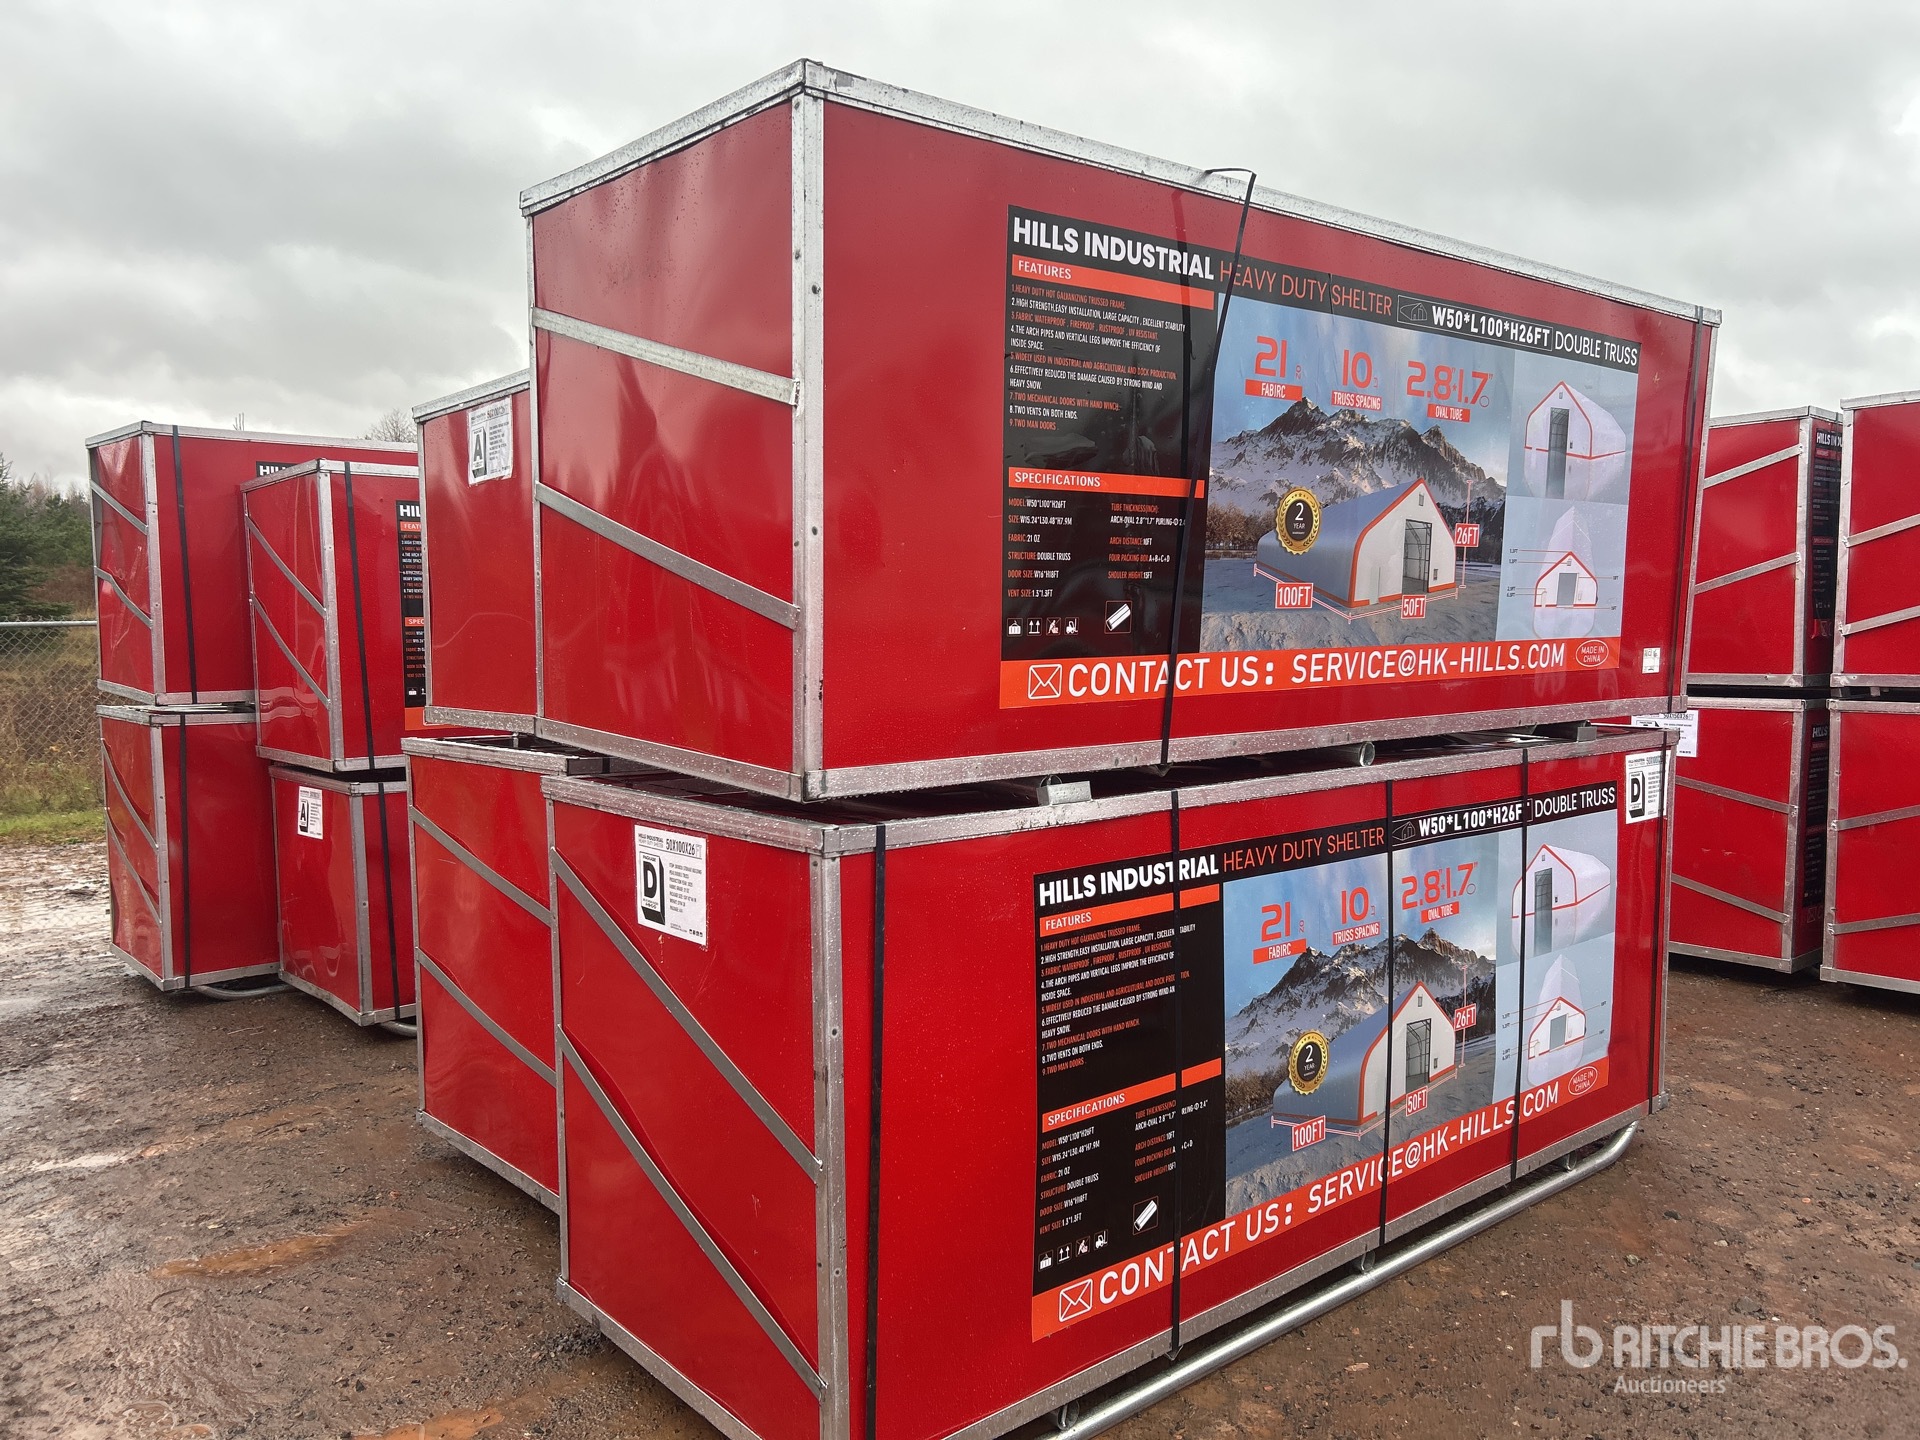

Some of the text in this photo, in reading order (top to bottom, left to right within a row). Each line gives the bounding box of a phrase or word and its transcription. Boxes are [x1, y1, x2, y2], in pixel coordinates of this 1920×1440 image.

[1018, 260, 1071, 280] FEATURES
[1013, 217, 1078, 253] HILLS
[1085, 231, 1214, 280] INDUSTRIAL
[1220, 261, 1277, 292] HEAVY
[1282, 275, 1328, 302] DUTY
[1332, 284, 1392, 316] SHELTER
[1556, 331, 1600, 358] DOUBLE
[1604, 342, 1637, 365] TRUSS
[1032, 287, 1044, 296] DUTY
[1046, 290, 1055, 298] HOT
[1103, 311, 1117, 321] LARGE
[1143, 318, 1164, 328] EXCELLENT
[1165, 321, 1185, 332] STABILITY
[1011, 338, 1026, 347] INSIDE
[1026, 327, 1039, 336] ARCH
[1041, 329, 1053, 338] PIPES
[1055, 331, 1065, 339] AND
[1066, 332, 1088, 343] VERTICAL
[1090, 335, 1100, 344] LEGS
[1102, 338, 1121, 347] IMPROVE
[1132, 341, 1154, 352] EFFICIENCY
[1034, 354, 1046, 363] USED
[1048, 356, 1052, 364] IN
[1054, 357, 1081, 367] INDUSTRIAL
[1083, 361, 1092, 369] AND
[1128, 366, 1136, 374] AND
[1255, 335, 1287, 378] 21
[1342, 349, 1373, 388] 10
[1010, 379, 1025, 387] HEAVY
[1045, 369, 1066, 379] REDUCED
[1068, 371, 1076, 380] THE
[1077, 373, 1096, 382] DAMAGE
[1098, 376, 1115, 384] CAUSED
[1124, 379, 1140, 388] STRONG
[1142, 381, 1153, 389] WIND
[1154, 382, 1162, 390] AND
[1261, 382, 1286, 398] FABIRC
[1027, 394, 1102, 408] MECHANICAL DOORS WITH HAND
[1334, 392, 1381, 410] TRUSS SPACING
[1010, 405, 1063, 418] 8.TWO VENTS ON BOTH
[1435, 405, 1463, 421] OVAL TUBE
[1027, 420, 1038, 428] MAN
[1816, 432, 1830, 444] HILLS
[474, 434, 482, 461] A
[1014, 472, 1100, 487] SPECIFICATIONS
[1295, 503, 1303, 520] 2
[1456, 527, 1478, 544] 26FT
[1008, 570, 1021, 578] DOOR
[1278, 586, 1311, 606] 100FT
[1403, 598, 1424, 616] 50FT
[1069, 643, 1565, 696] CONTACT US: SERVICE@HK-HILLS.COM
[1631, 778, 1640, 803] D
[300, 803, 306, 821] A
[1039, 874, 1096, 907] HILLS
[1223, 844, 1278, 872] HEAVY
[1282, 836, 1323, 862] DUTY
[1327, 827, 1384, 854] SHELTER
[1419, 802, 1530, 837] W50L100H26F
[1535, 792, 1577, 818] DOUBLE
[1580, 786, 1615, 808] TRUSS
[643, 861, 657, 898] D
[1342, 887, 1369, 924] 10
[1428, 904, 1453, 920] OVAL TUBE
[1046, 912, 1092, 931] FEATURES
[1261, 902, 1290, 942] 21
[1121, 933, 1154, 947] LARGE CAPACITY
[1335, 923, 1379, 945] TRUSS SPACING
[1268, 944, 1291, 959] FABIRC
[1055, 977, 1067, 985] ARCH
[1068, 973, 1080, 983] PIPES
[1081, 971, 1090, 980] AND
[1091, 967, 1109, 977] VERTICAL
[1111, 964, 1120, 973] LEGS
[1121, 960, 1139, 971] IMPROVE
[1148, 953, 1169, 964] EFFICIENCY
[1042, 991, 1056, 1001] INSIDE
[1073, 1007, 1092, 1018] REDUCED
[1102, 1000, 1119, 1011] DAMAGE
[1120, 997, 1135, 1007] CAUSED
[1136, 994, 1142, 1002] BY
[1143, 990, 1158, 1000] STRONG
[1456, 1006, 1475, 1028] 26FT
[1042, 1029, 1056, 1039] HEAVY
[1058, 1049, 1071, 1059] VENTS
[1072, 1047, 1078, 1055] ON
[1079, 1043, 1090, 1053] BOTH
[1306, 1045, 1313, 1062] 2
[1572, 1071, 1594, 1085] MADE IN
[1575, 1080, 1590, 1091] CHINA
[1048, 1093, 1125, 1126] SPECIFICATIONS
[1407, 1088, 1427, 1114] 50FT
[1294, 1119, 1324, 1148] 100FT
[1246, 1202, 1293, 1241] US:
